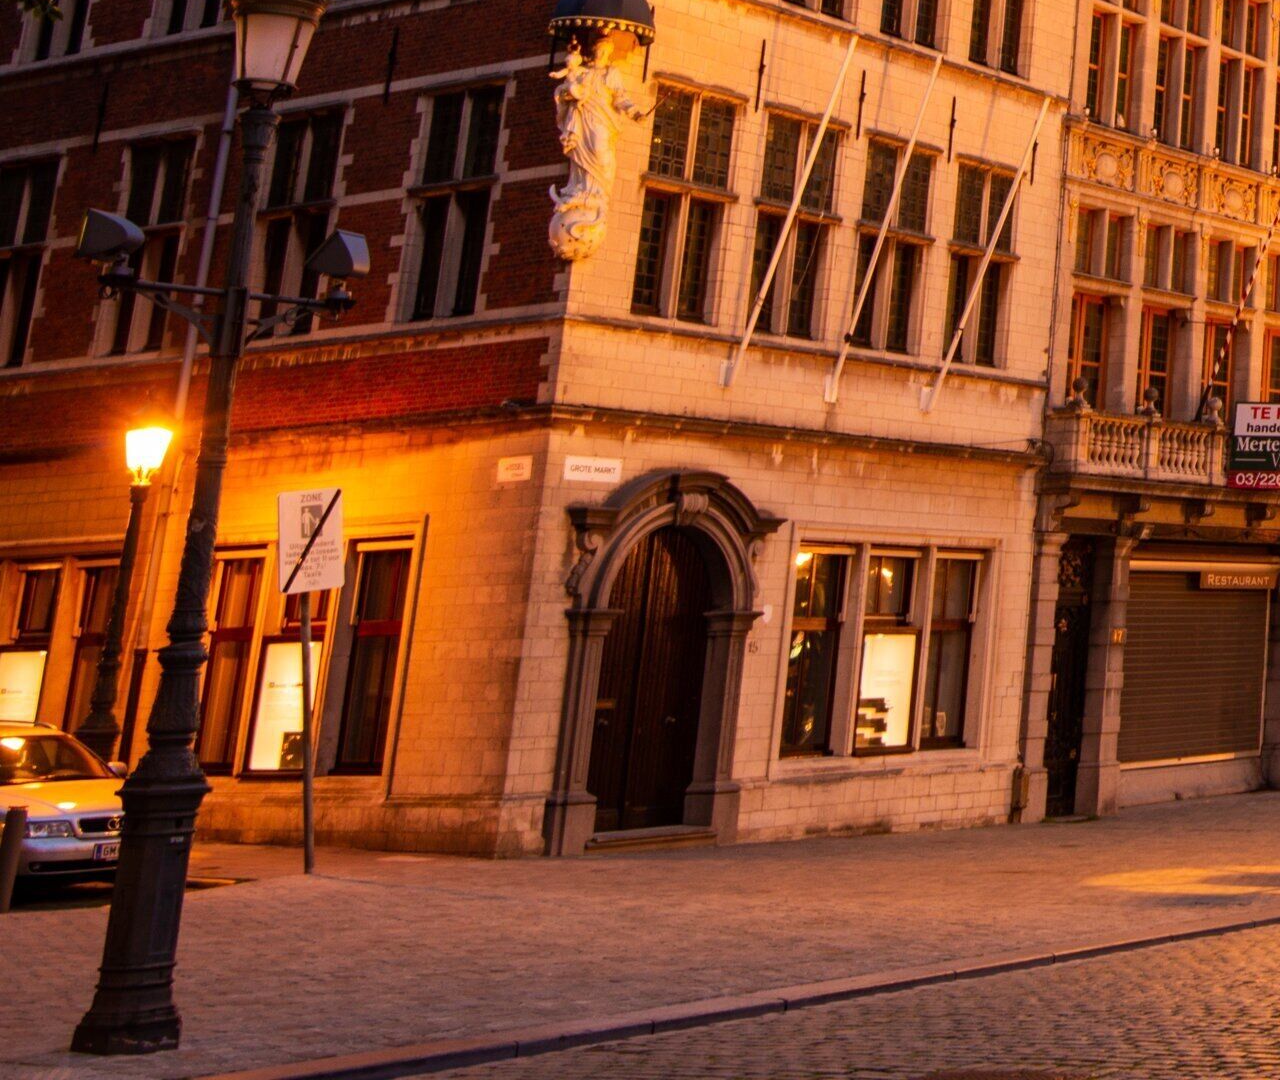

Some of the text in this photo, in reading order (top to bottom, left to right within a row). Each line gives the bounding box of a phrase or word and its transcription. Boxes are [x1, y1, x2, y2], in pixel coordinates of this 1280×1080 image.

[1251, 407, 1271, 420] TE
[570, 464, 617, 475] GROTE MARKT
[300, 493, 322, 503] ZONE
